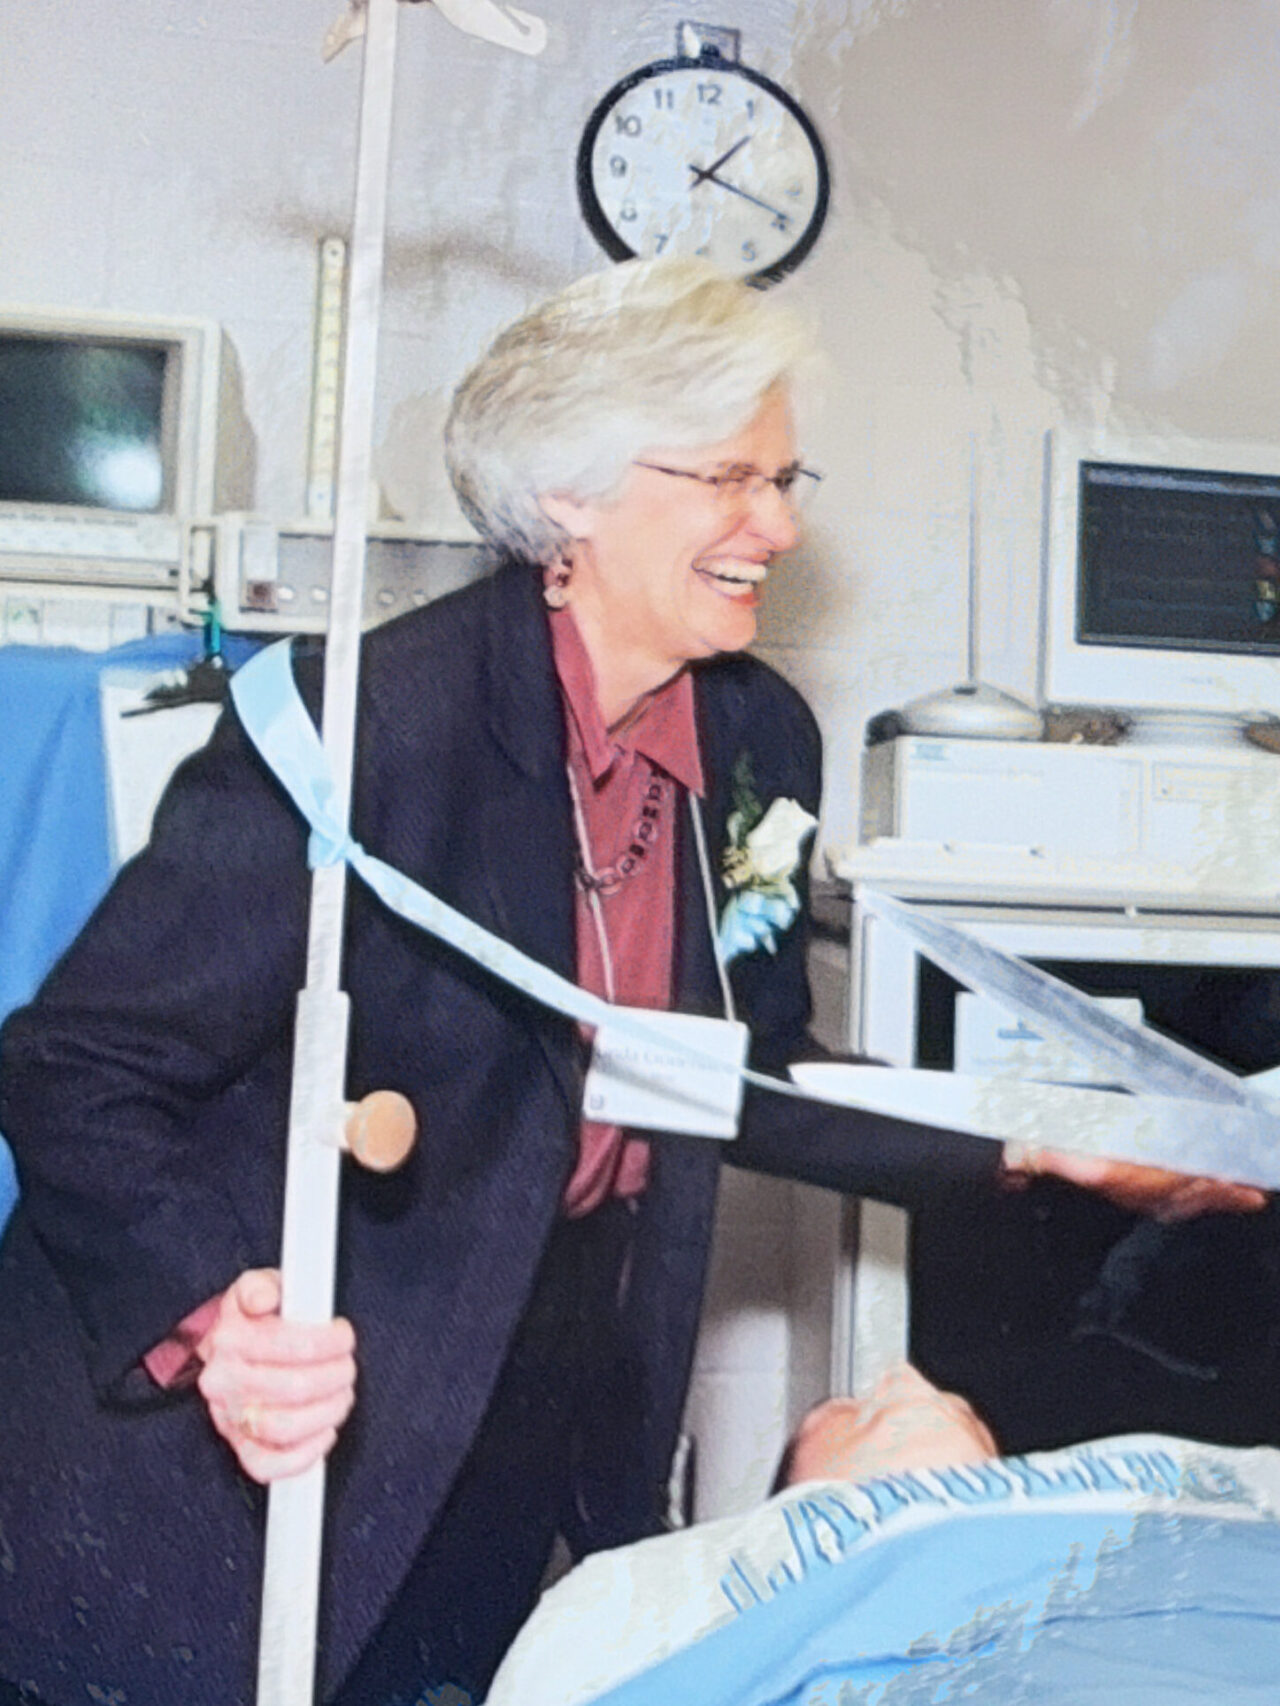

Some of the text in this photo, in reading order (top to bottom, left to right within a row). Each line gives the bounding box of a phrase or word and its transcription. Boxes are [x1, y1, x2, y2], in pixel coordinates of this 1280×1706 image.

[654, 88, 674, 109] 11
[698, 84, 721, 104] 12
[747, 100, 754, 119] 1
[615, 115, 642, 137] 10
[610, 155, 627, 176] 9
[655, 234, 667, 253] 7
[742, 241, 755, 261] 5
